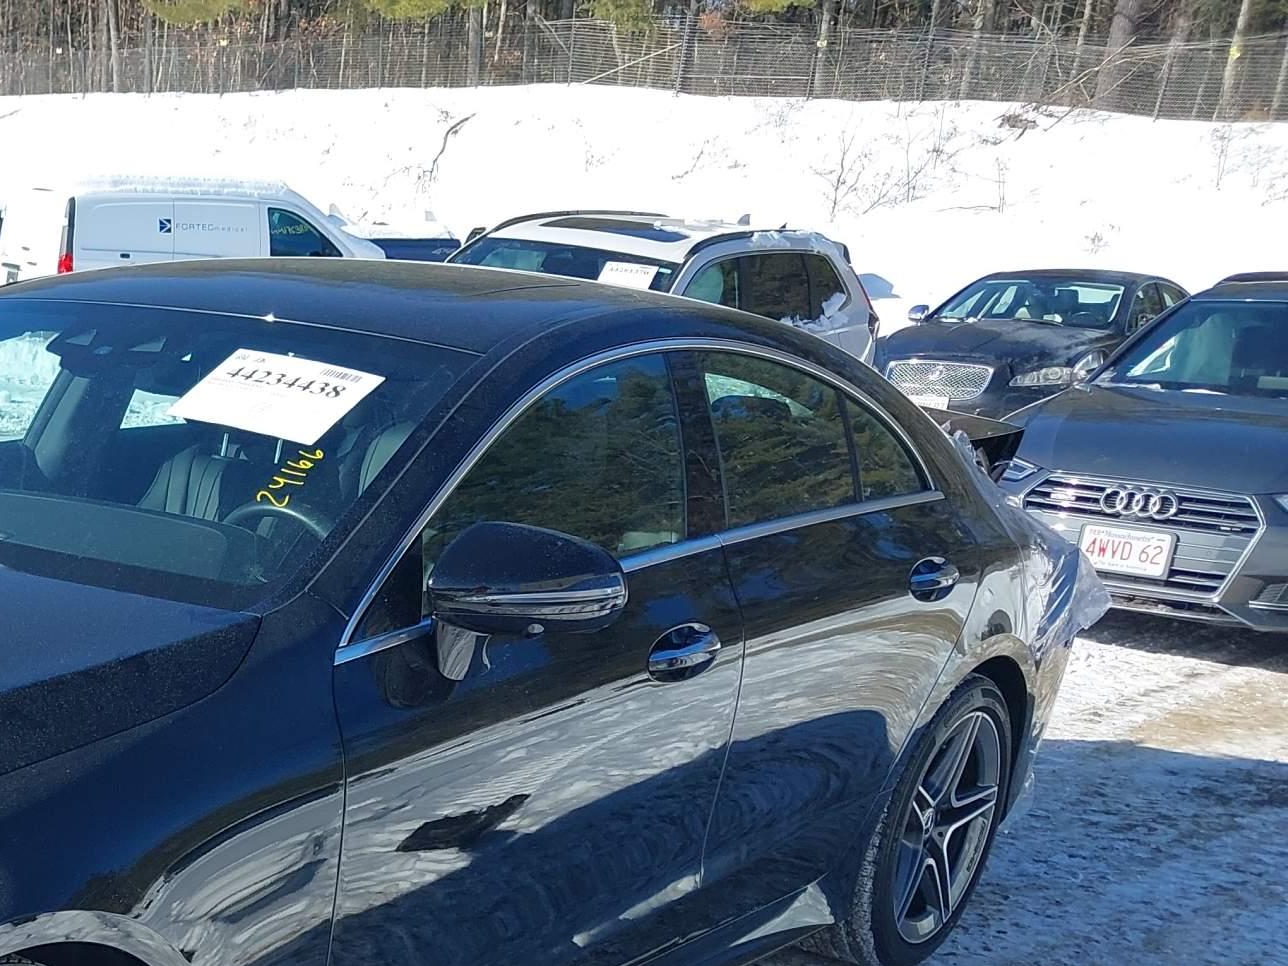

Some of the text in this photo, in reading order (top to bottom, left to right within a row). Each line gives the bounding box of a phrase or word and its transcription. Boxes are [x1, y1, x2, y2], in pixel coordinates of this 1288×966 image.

[226, 366, 347, 399] 44234438
[256, 449, 324, 508] 24166
[1085, 537, 1133, 561] 4WVD
[1138, 544, 1164, 566] 62
